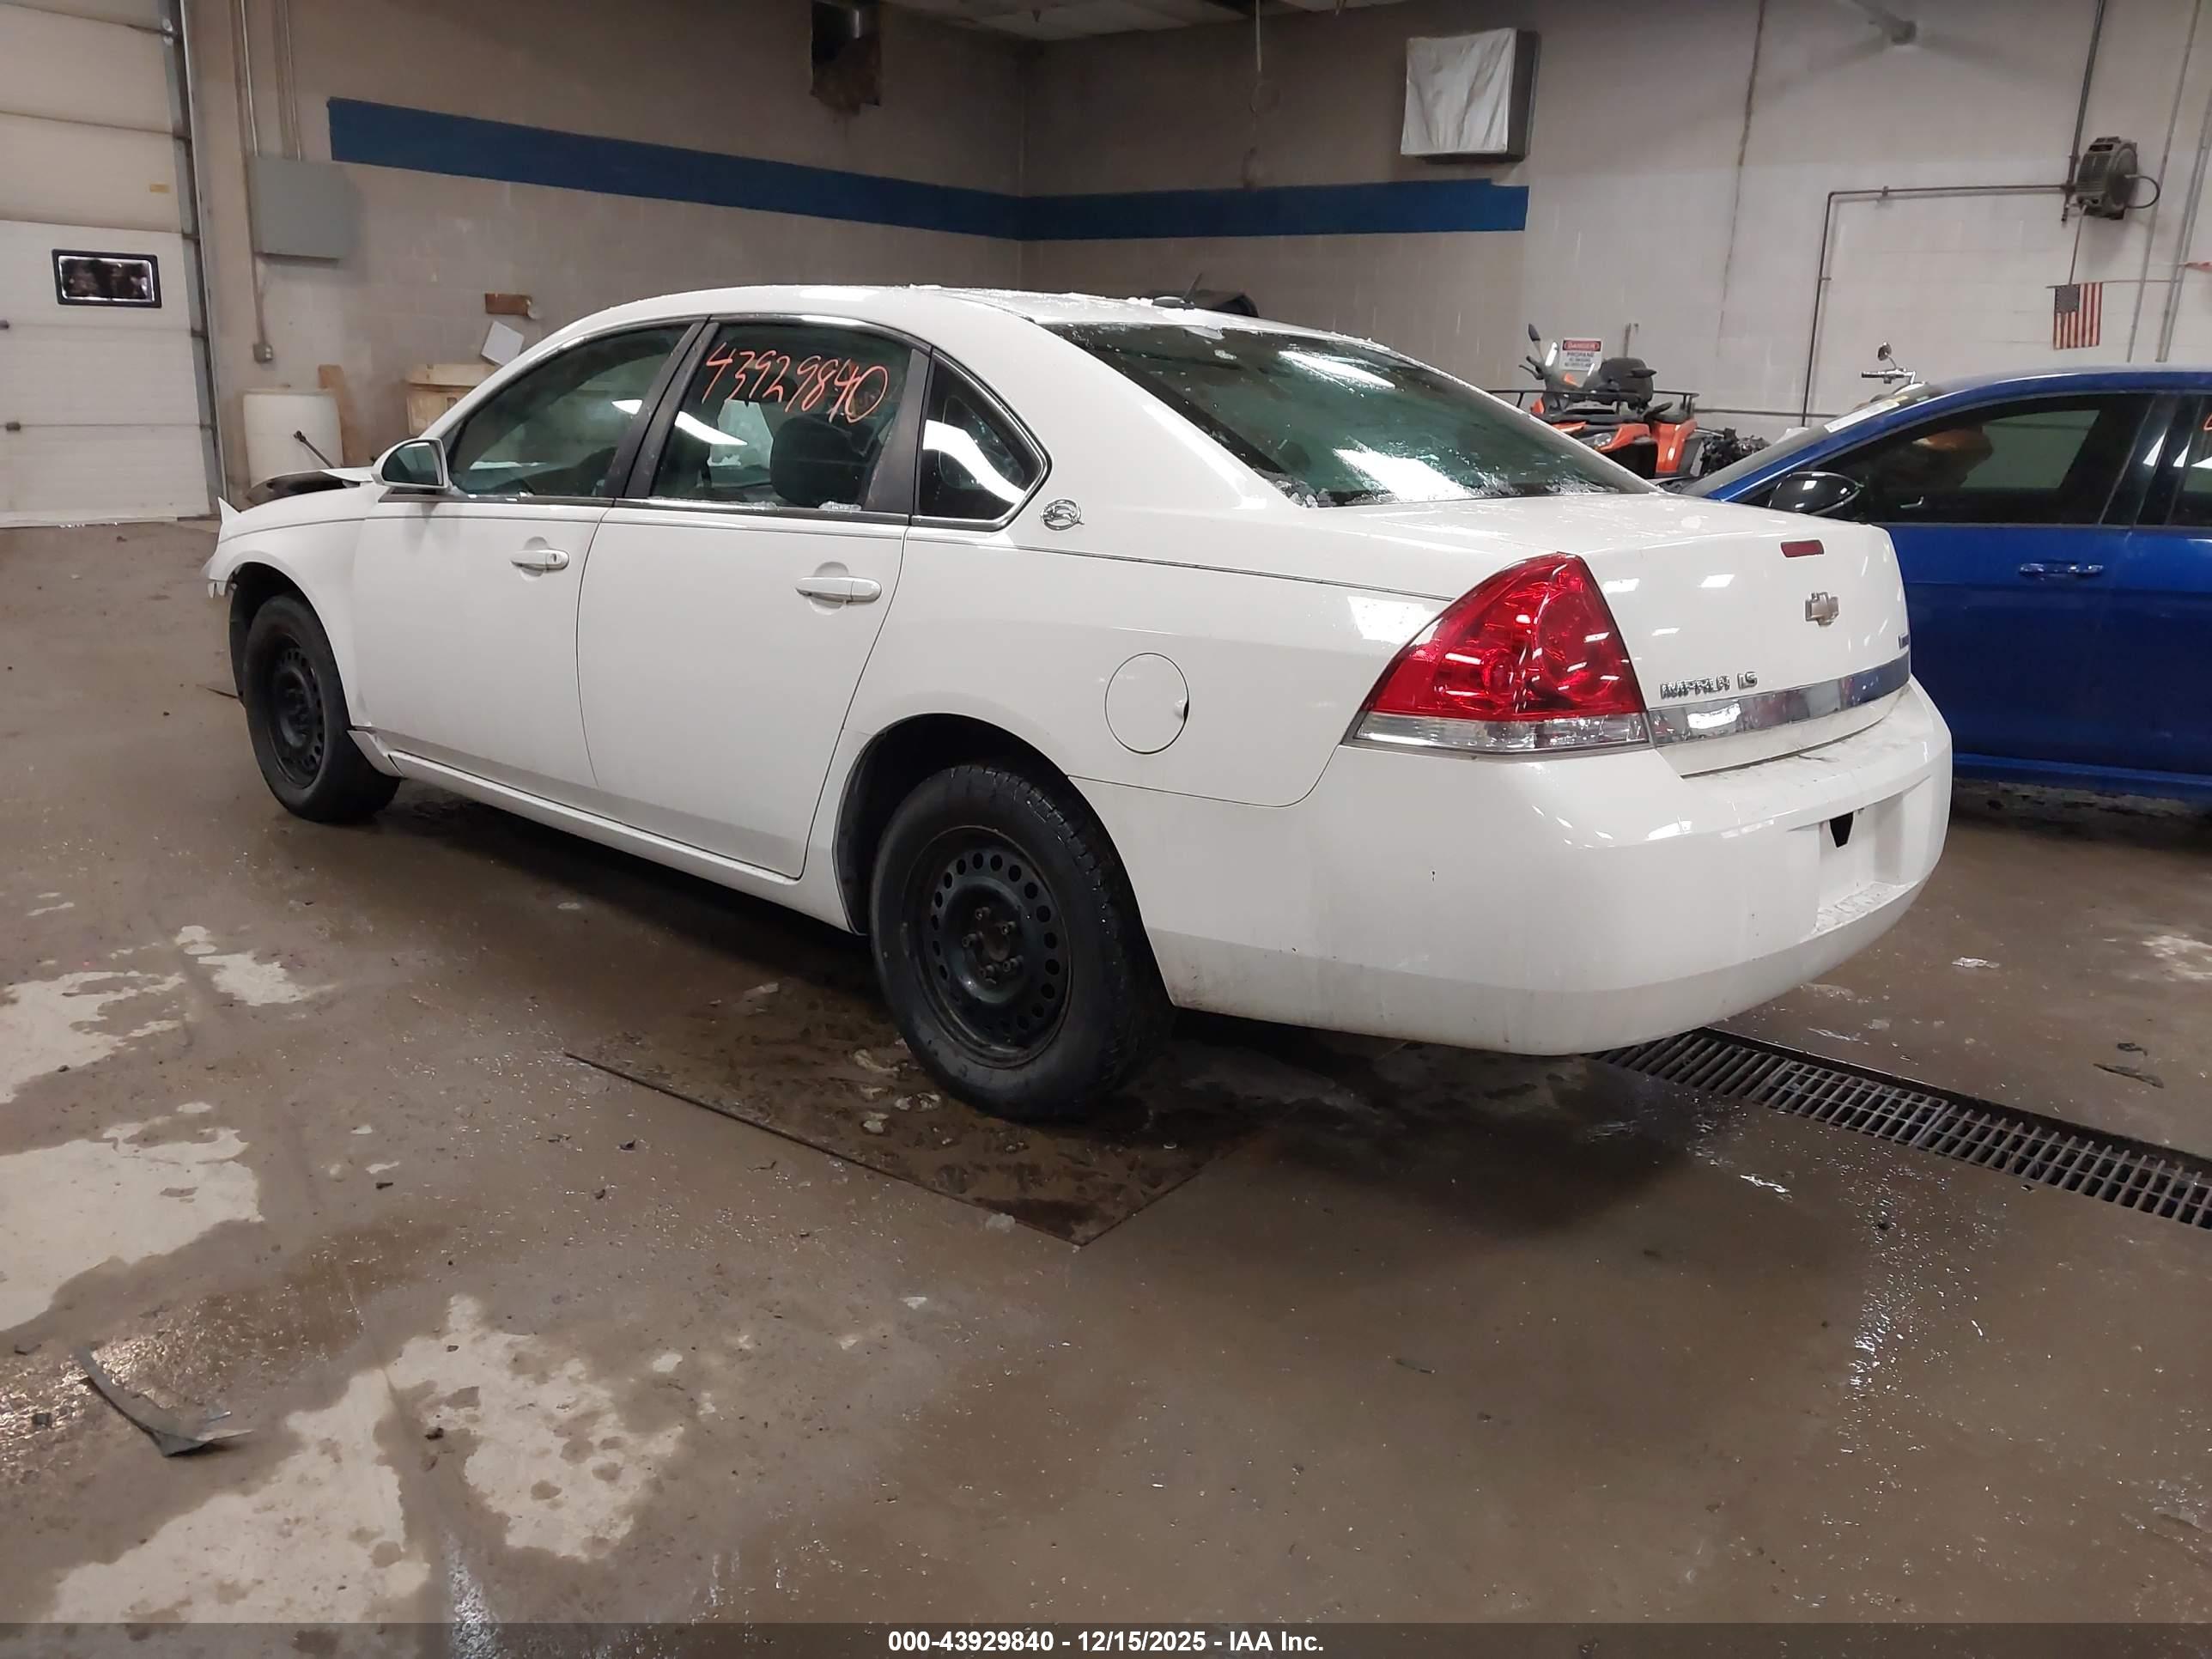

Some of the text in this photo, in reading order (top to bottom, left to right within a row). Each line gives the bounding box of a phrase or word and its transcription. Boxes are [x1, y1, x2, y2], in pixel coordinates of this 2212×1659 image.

[702, 342, 888, 424] 43929840
[1660, 671, 1758, 699] IMPALA LS
